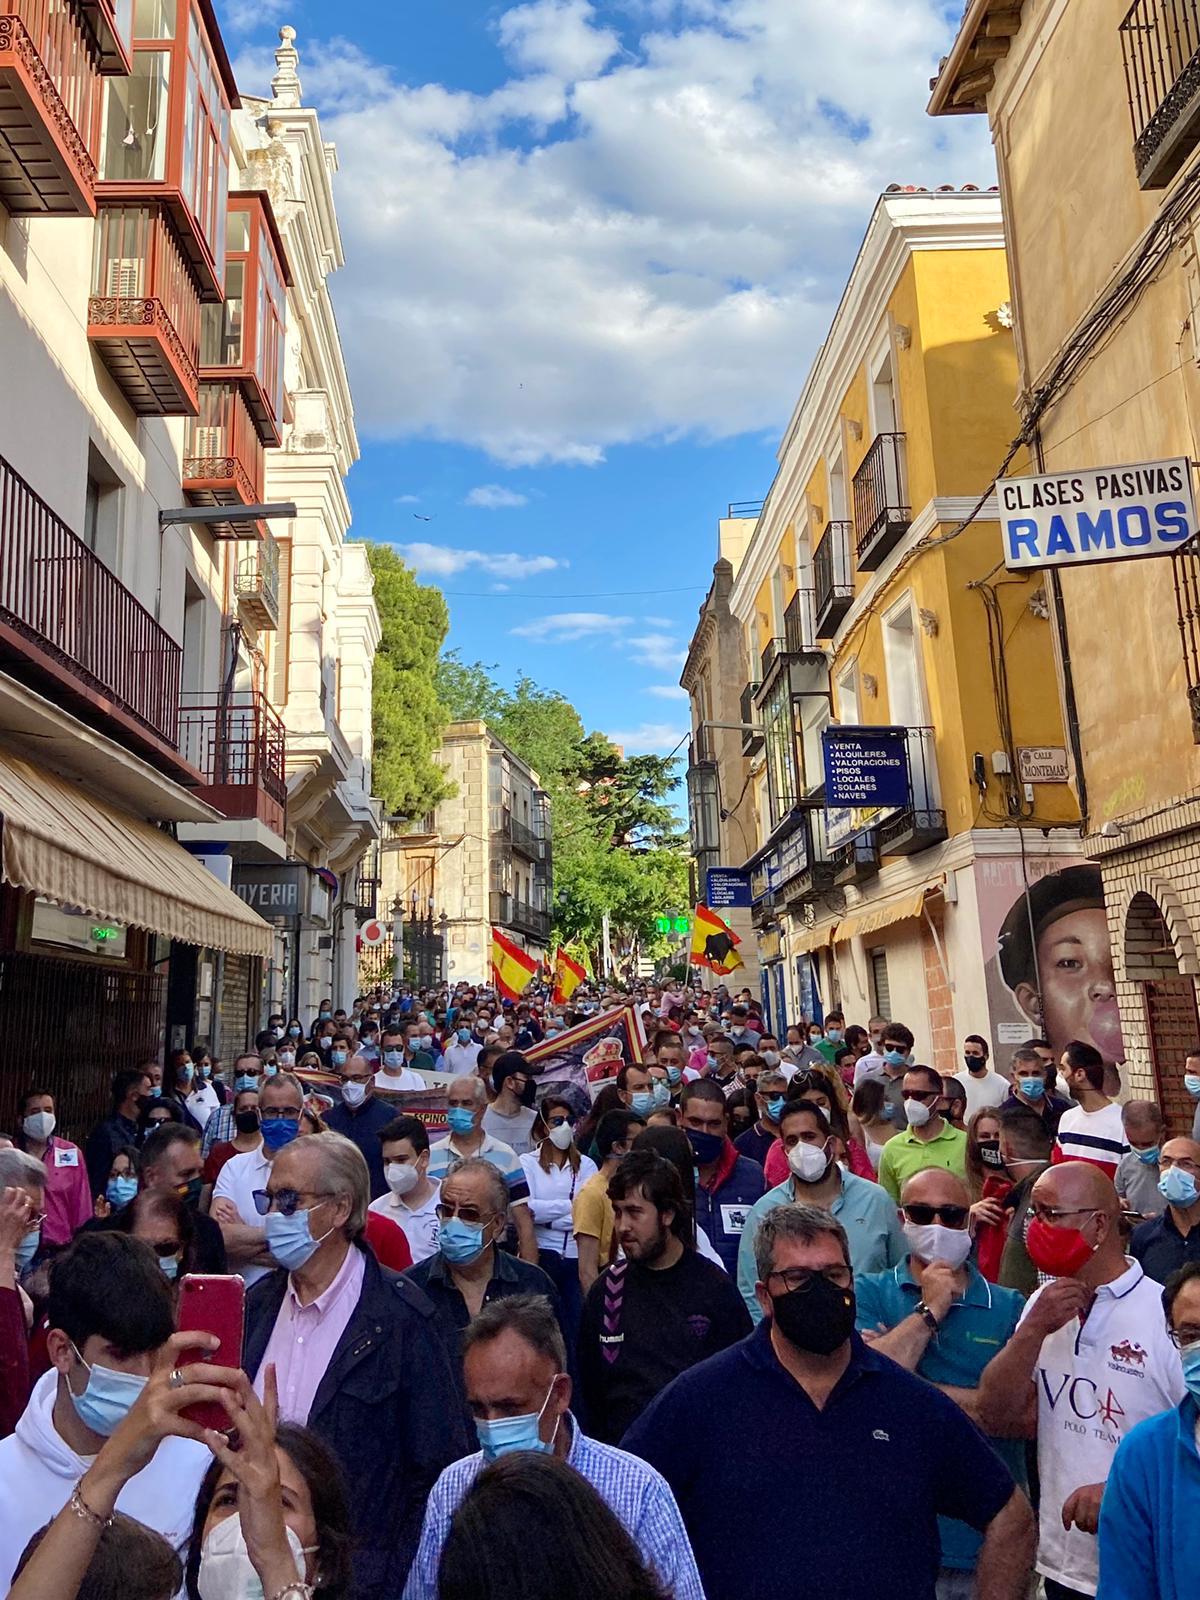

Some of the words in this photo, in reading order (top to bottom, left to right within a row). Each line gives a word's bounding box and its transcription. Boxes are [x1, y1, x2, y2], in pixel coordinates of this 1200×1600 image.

[1003, 478, 1084, 511] CLASES
[1095, 466, 1184, 500] PASIVAS
[1007, 501, 1190, 560] RAMOS
[834, 750, 887, 758] ALQUILERES
[1033, 752, 1053, 760] CALLE
[836, 775, 876, 783] LOCALES
[232, 884, 298, 905] OYERIA
[599, 1332, 625, 1343] hummel
[1063, 1420, 1087, 1435] POLO
